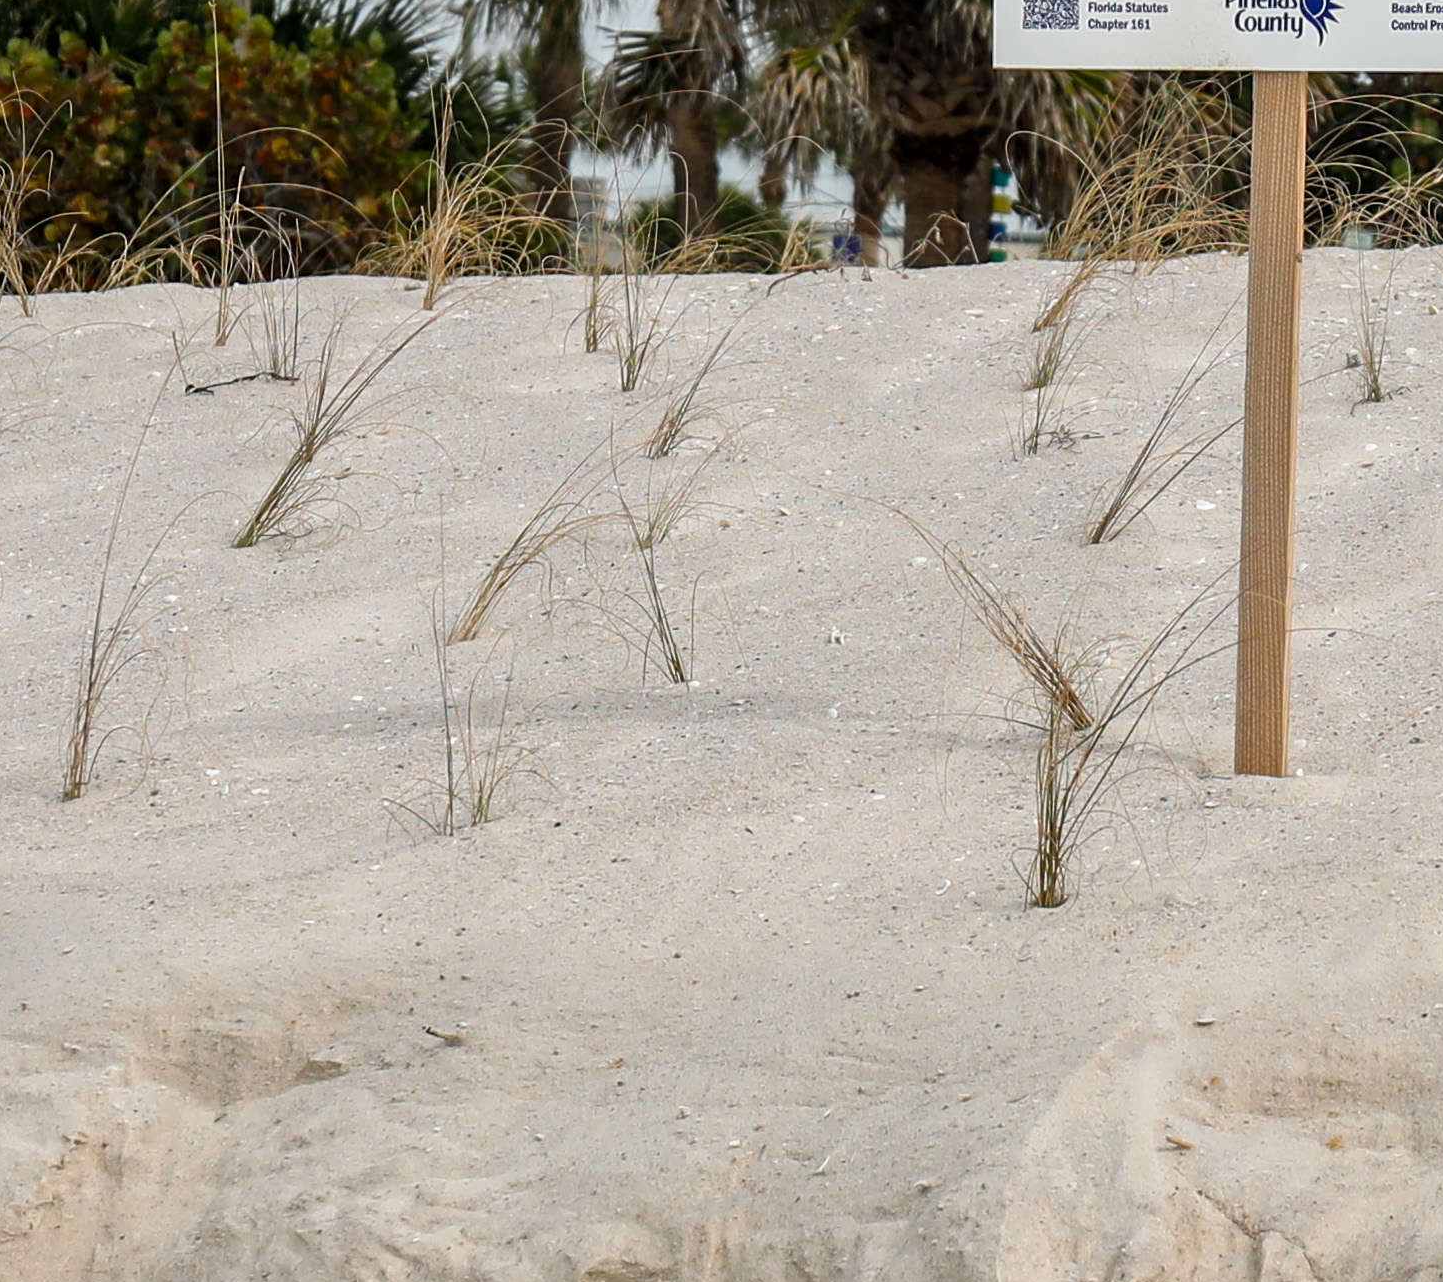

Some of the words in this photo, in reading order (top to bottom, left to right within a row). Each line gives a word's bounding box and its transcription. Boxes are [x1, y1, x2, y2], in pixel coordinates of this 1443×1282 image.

[1089, 2, 1122, 12] Florida
[1126, 2, 1168, 13] Statutes
[1392, 3, 1422, 13] Beach
[1088, 19, 1128, 31] Chapter
[1132, 19, 1150, 29] 161
[1235, 11, 1304, 38] County
[1392, 20, 1427, 30] Control
